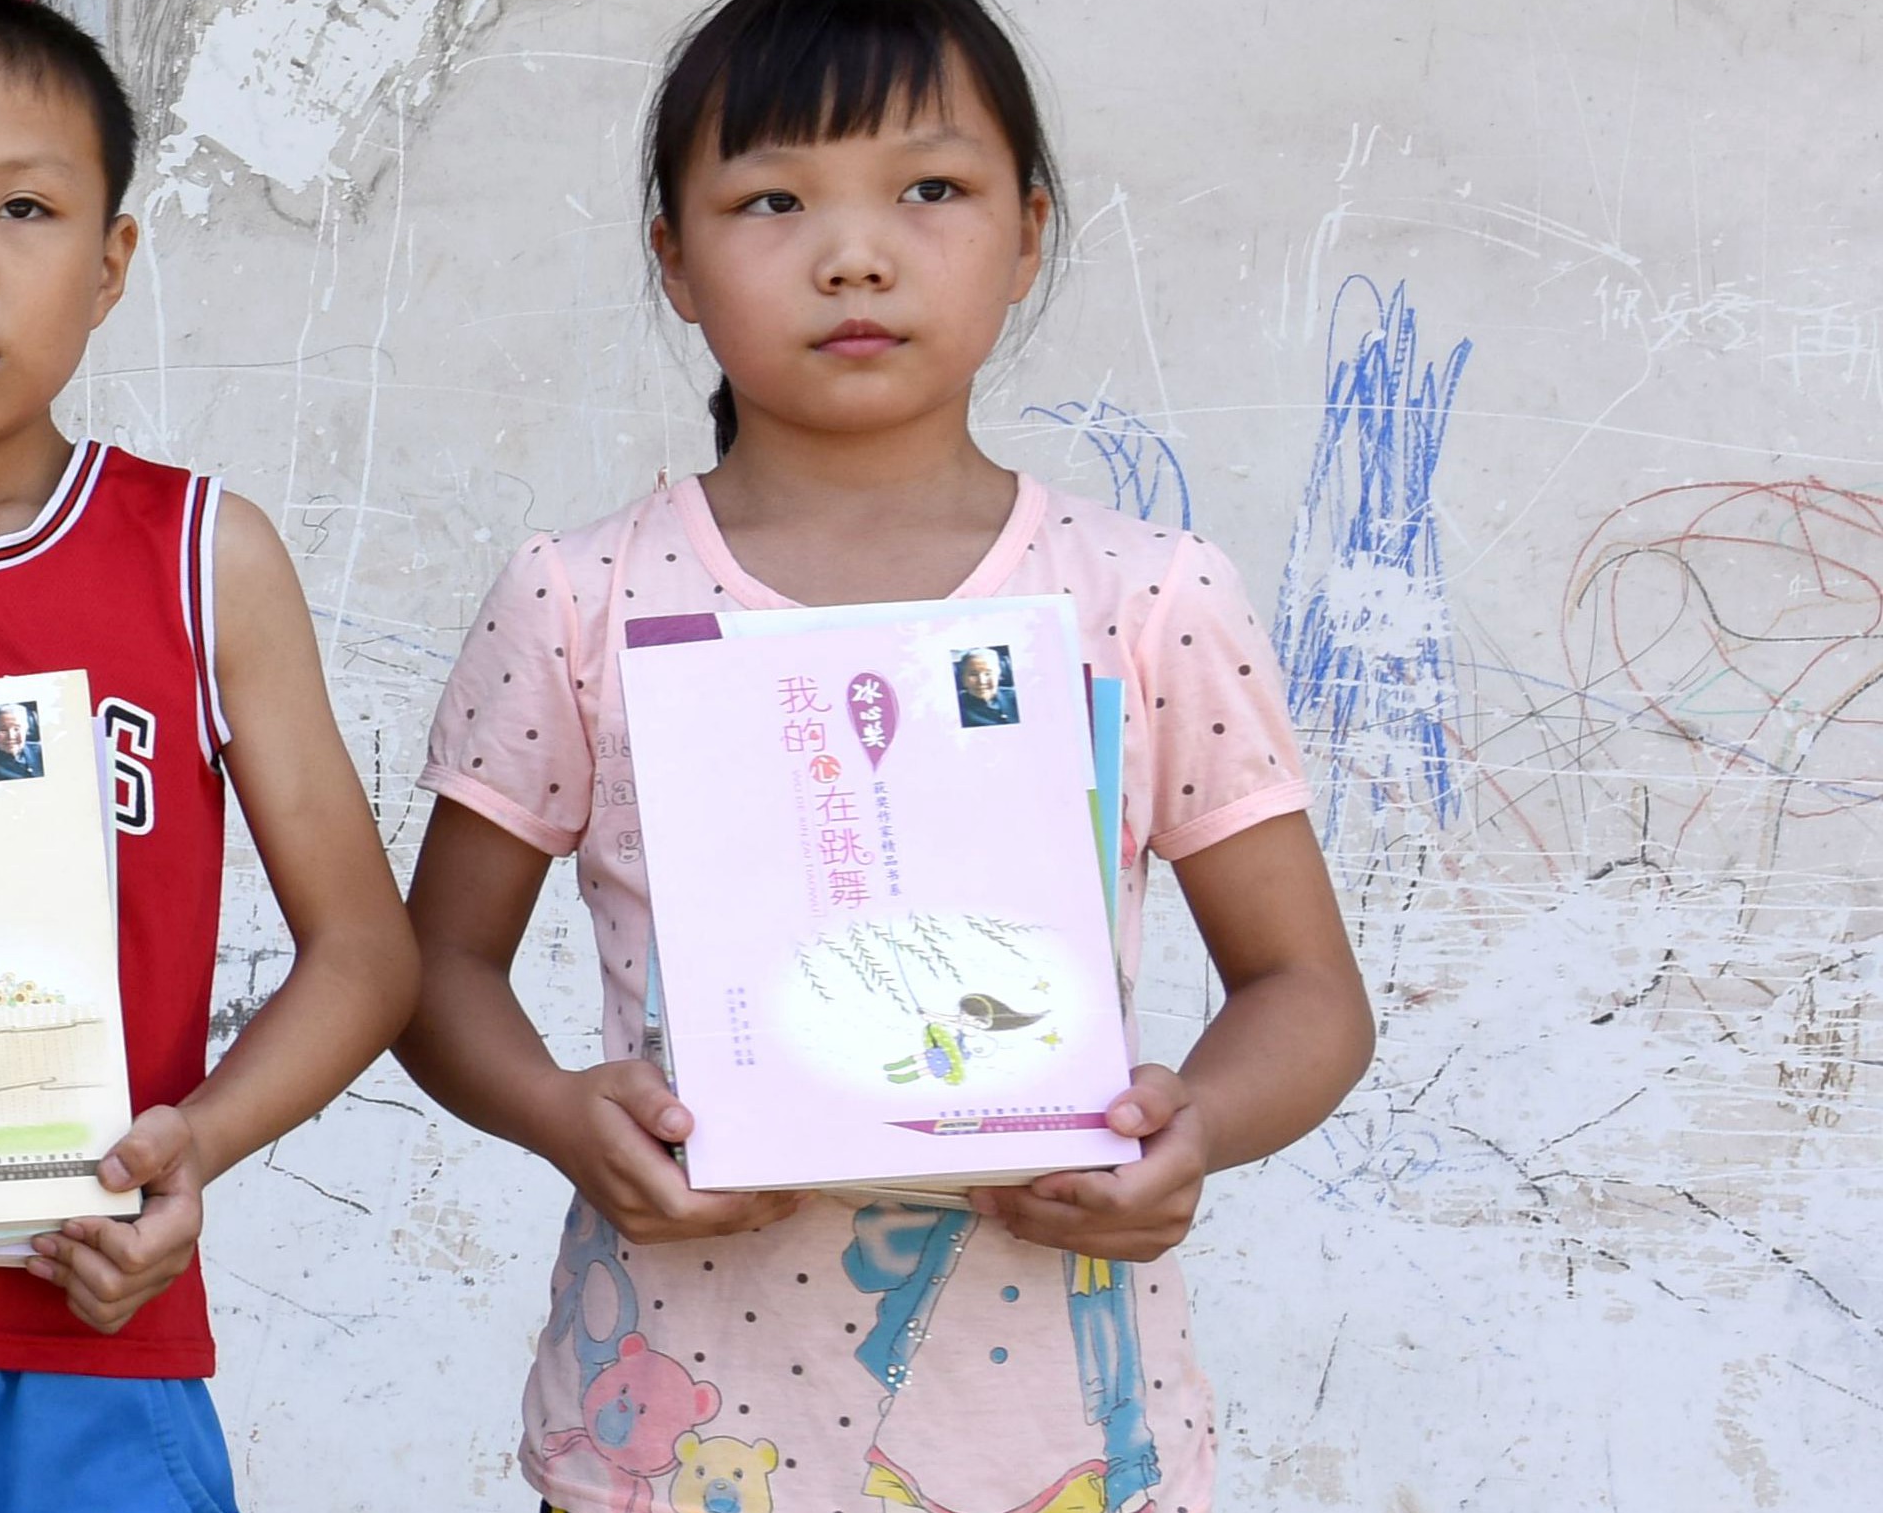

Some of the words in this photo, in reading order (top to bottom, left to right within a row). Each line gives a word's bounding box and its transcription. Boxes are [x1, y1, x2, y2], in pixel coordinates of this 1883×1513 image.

[851, 679, 887, 748] 冰心奖
[778, 676, 876, 910] 我的心在跳舞
